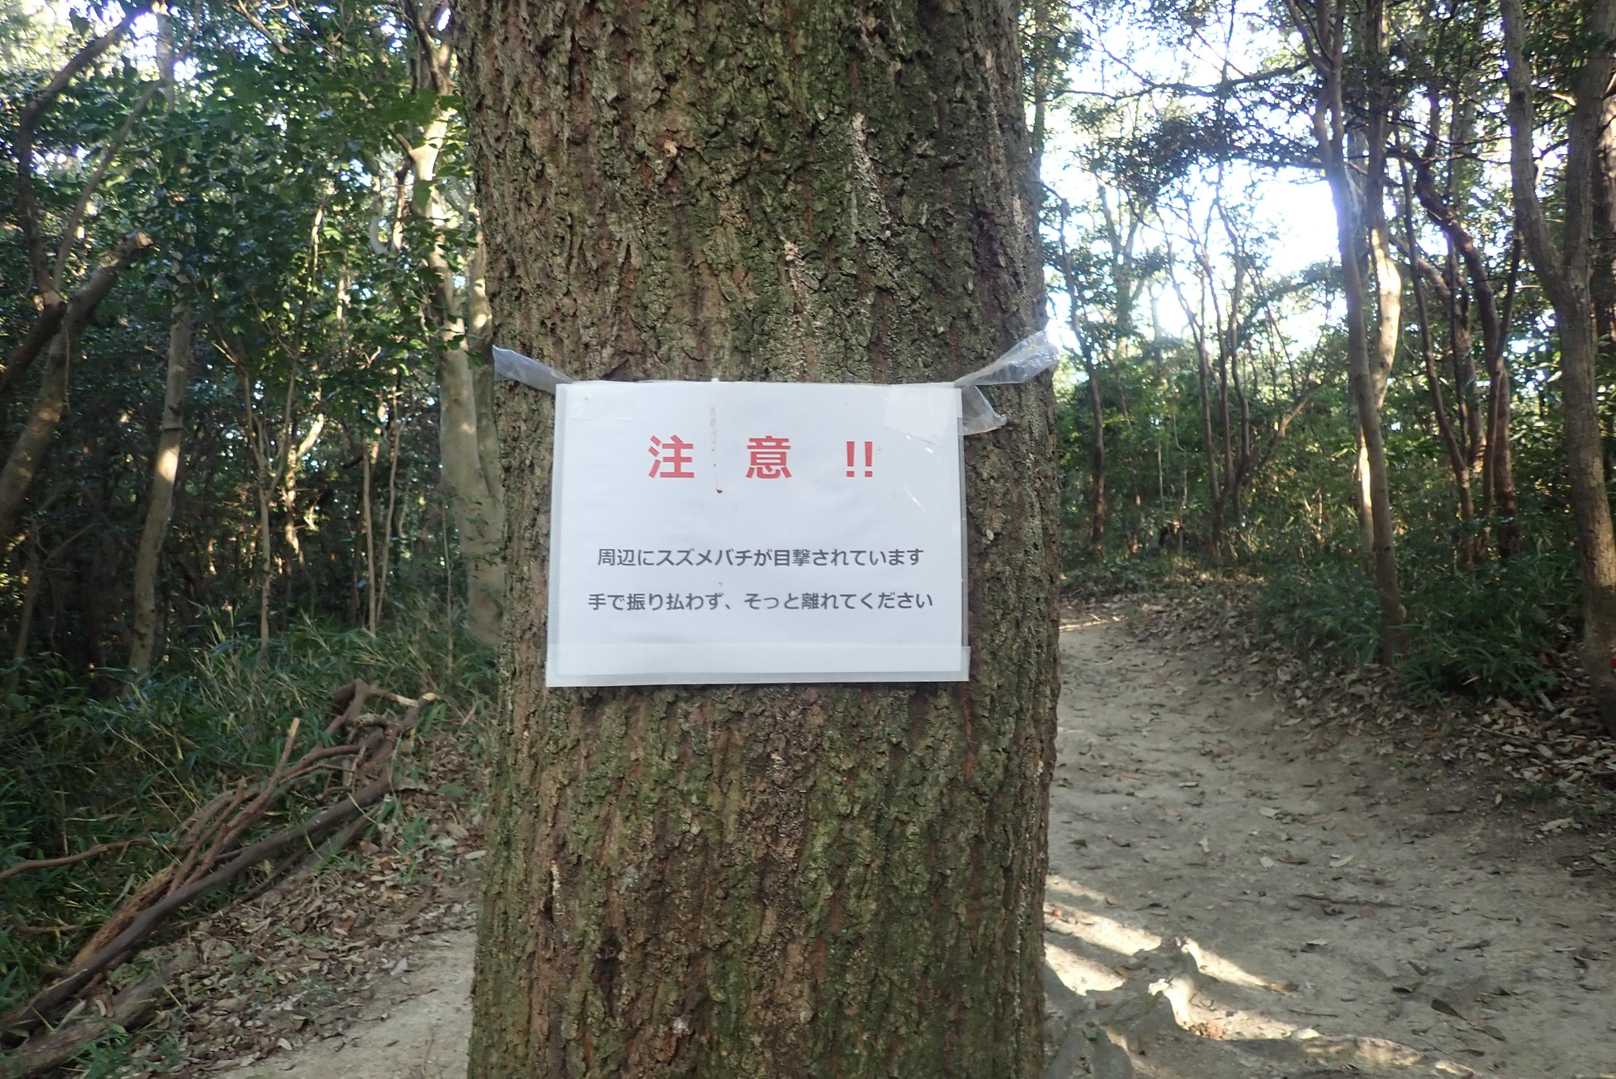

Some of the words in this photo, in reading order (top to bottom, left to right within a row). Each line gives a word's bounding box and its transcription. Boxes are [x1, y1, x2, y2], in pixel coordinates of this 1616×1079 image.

[597, 548, 924, 567] 周辺にスズメバチが目撃されています
[587, 592, 933, 611] 手で振り払わず、そっと離れてください
